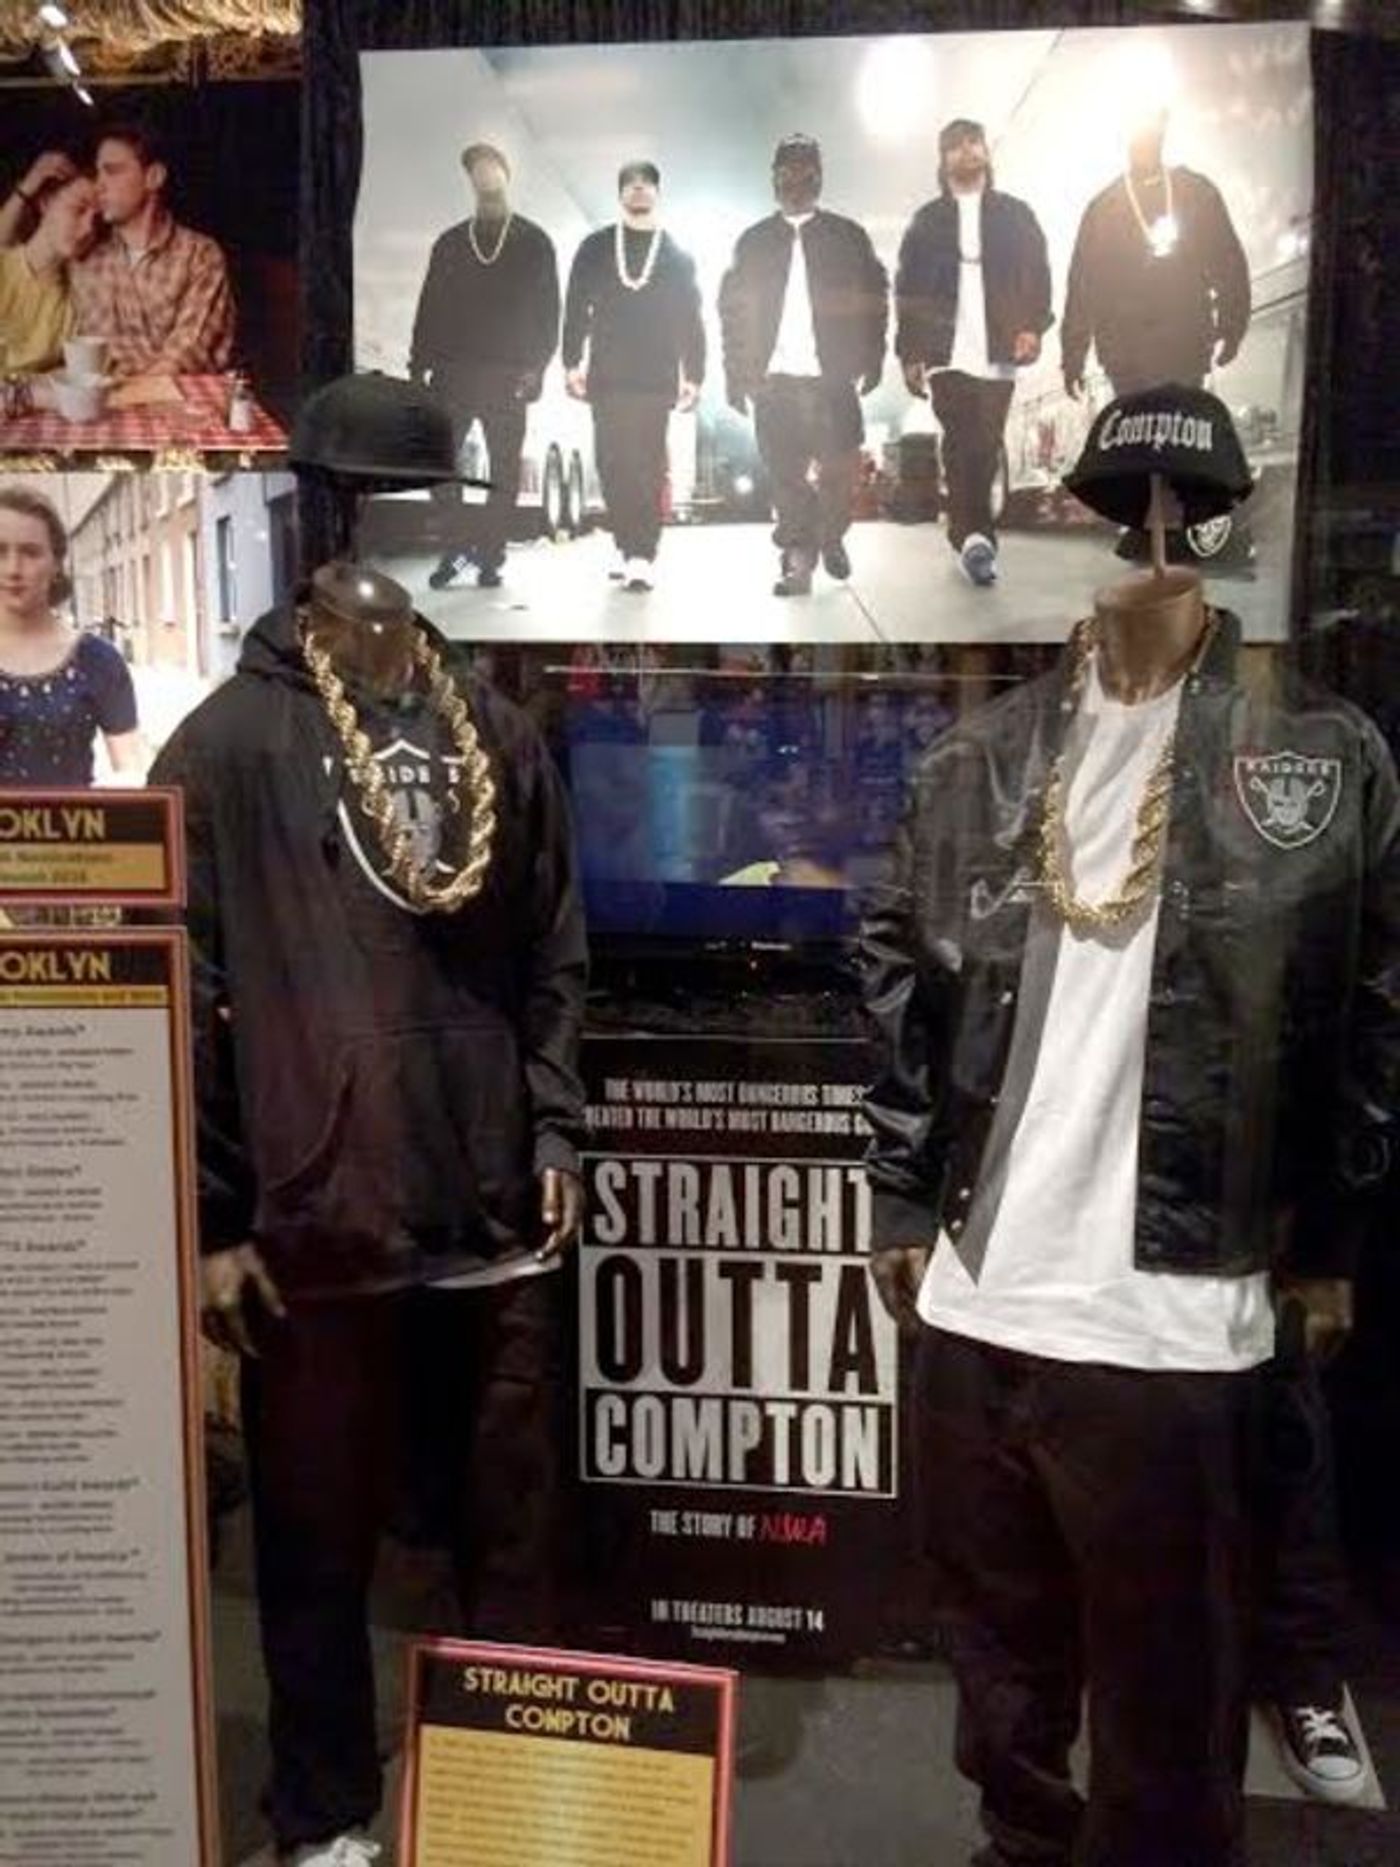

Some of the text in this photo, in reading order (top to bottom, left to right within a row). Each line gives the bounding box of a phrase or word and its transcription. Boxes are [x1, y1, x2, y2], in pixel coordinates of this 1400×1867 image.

[1100, 409, 1213, 452] Compton
[0, 809, 106, 839] OKLYN
[0, 951, 112, 981] OKLYN
[594, 1161, 872, 1252] STRAIGHT
[596, 1255, 879, 1395] OUTTA
[595, 1394, 880, 1490] COMPTON
[651, 1510, 679, 1535] THE
[681, 1512, 732, 1538] STORY
[735, 1514, 756, 1540] OF
[651, 1599, 824, 1632] IN THEATERS AUGUST 14
[464, 1667, 674, 1713] STRAIGHT OUTTA
